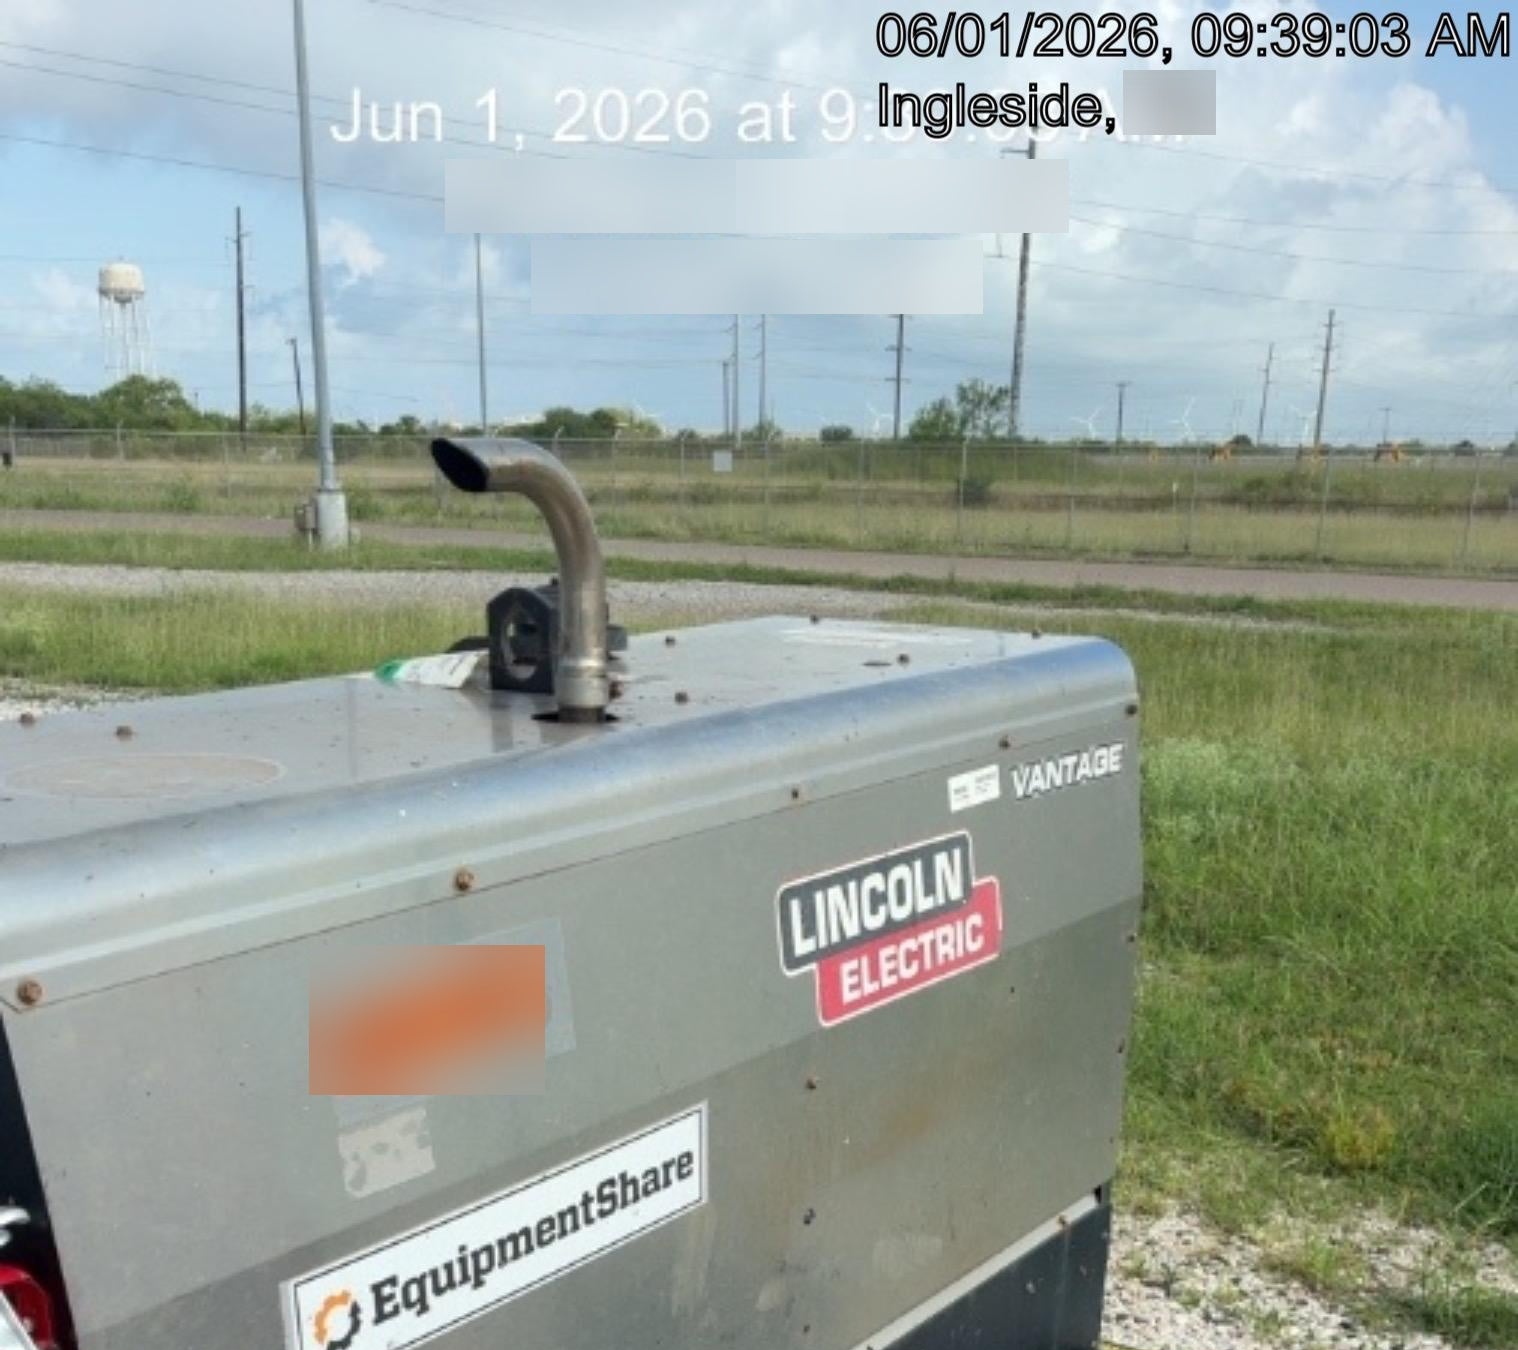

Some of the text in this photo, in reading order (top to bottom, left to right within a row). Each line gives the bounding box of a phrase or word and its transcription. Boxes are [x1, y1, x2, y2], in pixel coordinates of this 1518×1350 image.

[1010, 743, 1125, 800] VANTAGE
[789, 846, 965, 959] LINCOLN
[838, 913, 986, 1006] ELECTRIC
[370, 1150, 695, 1326] EquipmentShare
